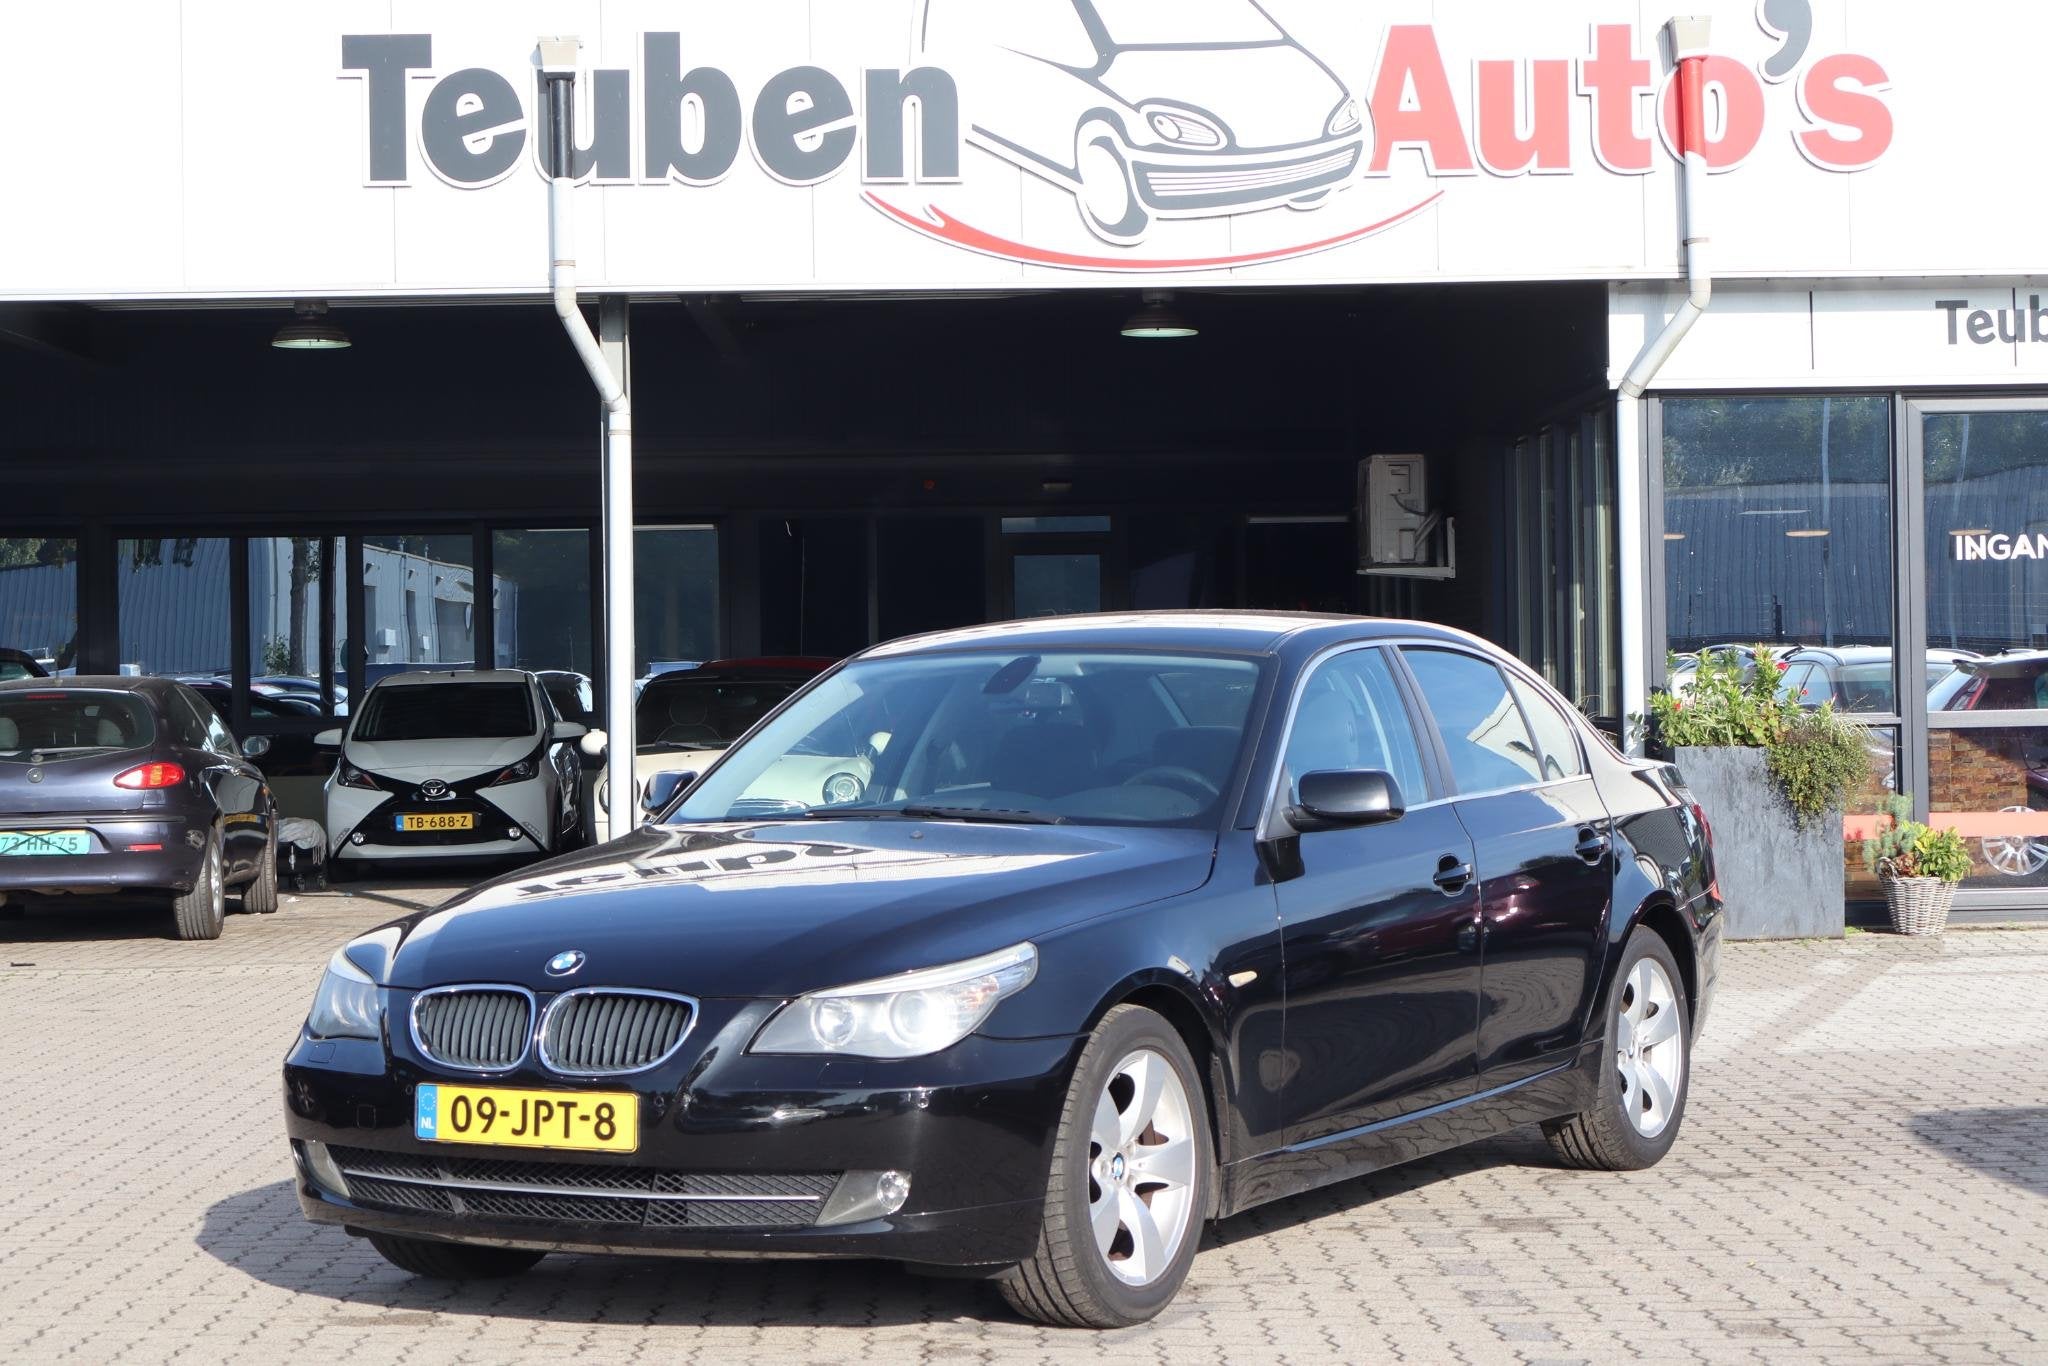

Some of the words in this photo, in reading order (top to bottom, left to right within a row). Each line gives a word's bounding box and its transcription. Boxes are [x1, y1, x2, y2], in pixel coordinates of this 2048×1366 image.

[341, 31, 960, 184] Teuben
[1367, 0, 1894, 176] Auto's
[407, 815, 468, 829] TB-688-Z
[1, 836, 78, 851] 73HH-75
[421, 1116, 435, 1130] NL
[451, 1095, 616, 1141] 09-JPT-8
